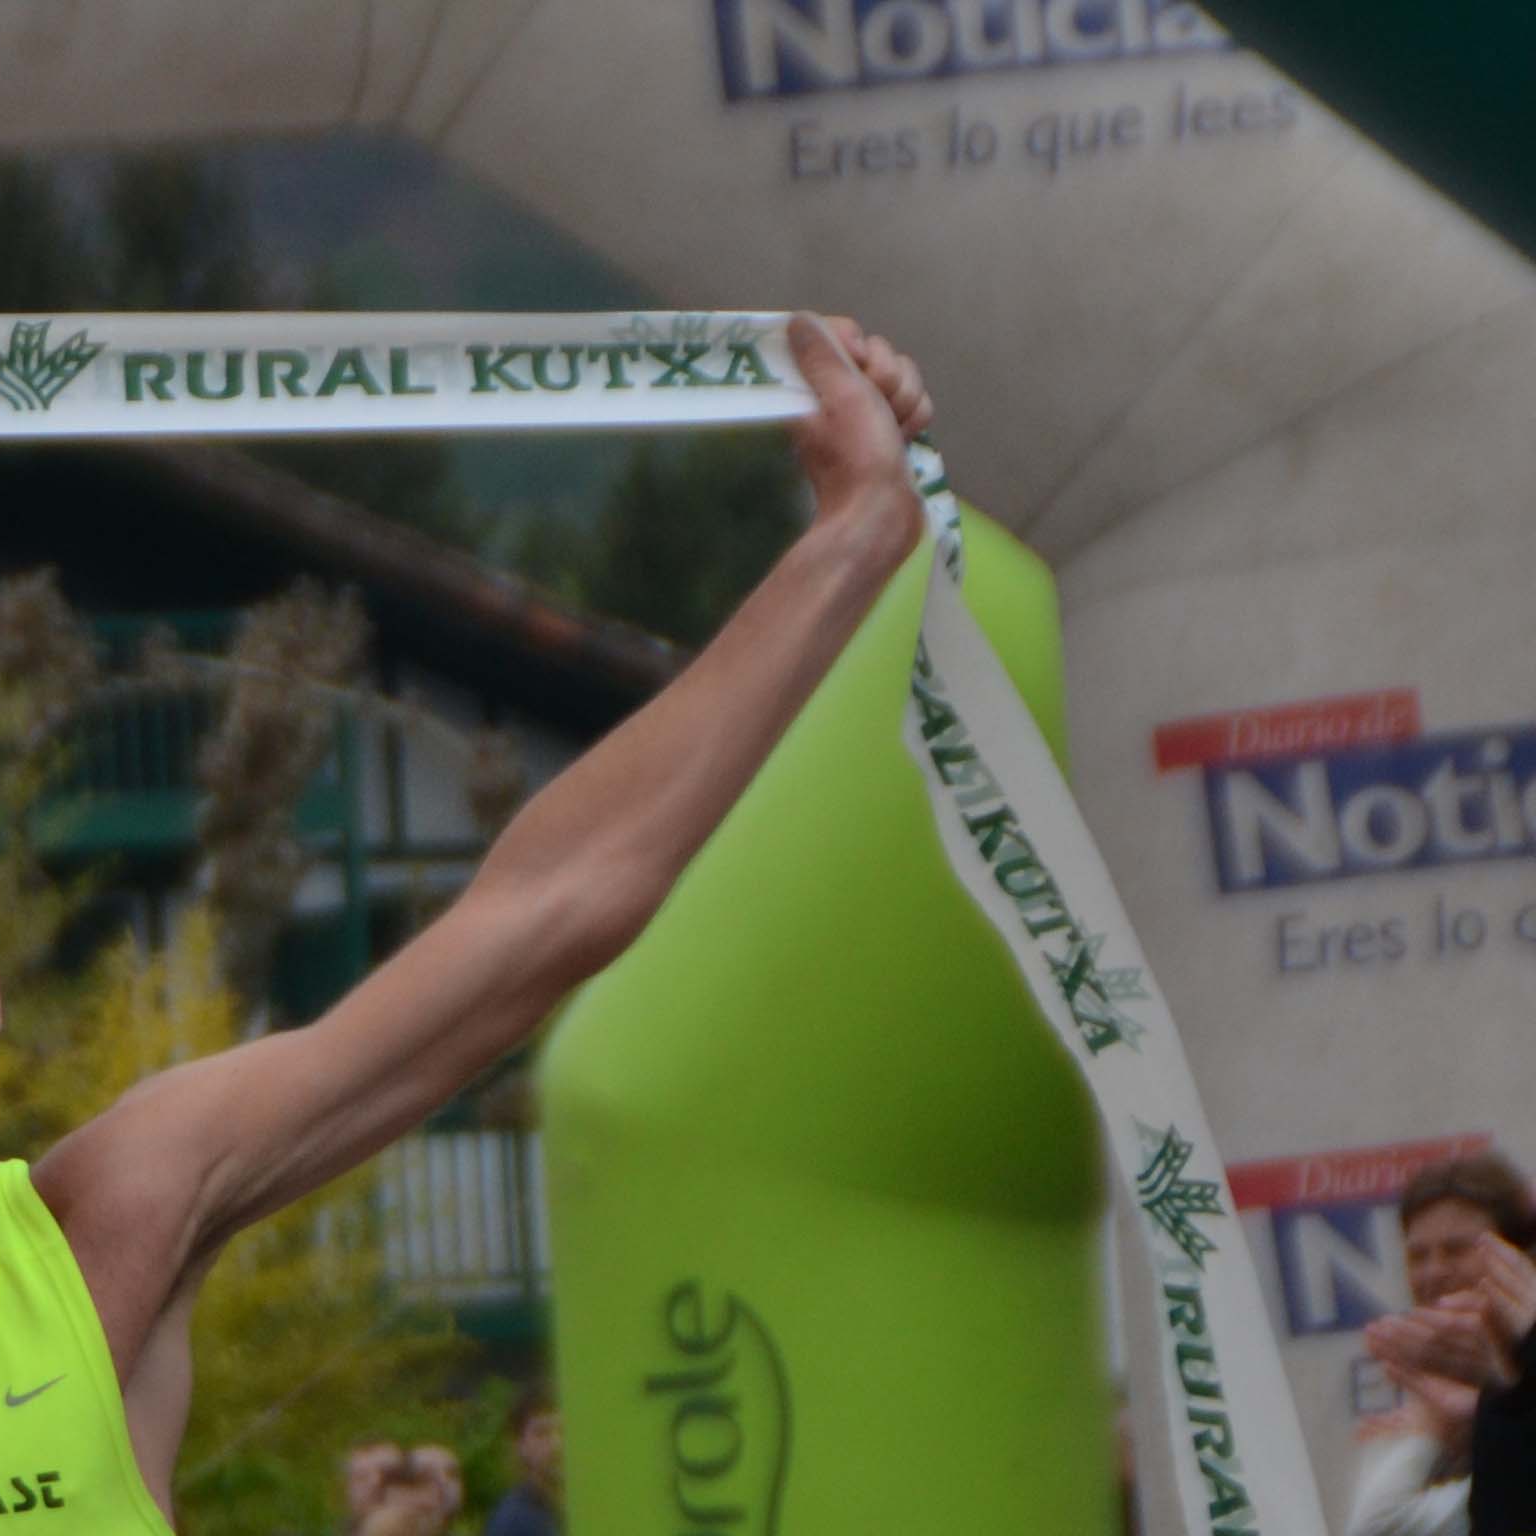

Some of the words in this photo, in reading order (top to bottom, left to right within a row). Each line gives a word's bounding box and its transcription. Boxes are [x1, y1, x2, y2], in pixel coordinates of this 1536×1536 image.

[790, 121, 919, 178] Eres
[948, 105, 997, 167] lo
[1028, 104, 1144, 173] que
[1172, 82, 1297, 140] lees
[125, 346, 436, 403] RURAL
[466, 341, 784, 394] KUTXA
[1227, 734, 1536, 881] Noti
[960, 801, 1122, 1057] KUTXA
[1275, 912, 1407, 971] Eres
[1436, 893, 1488, 952] lo
